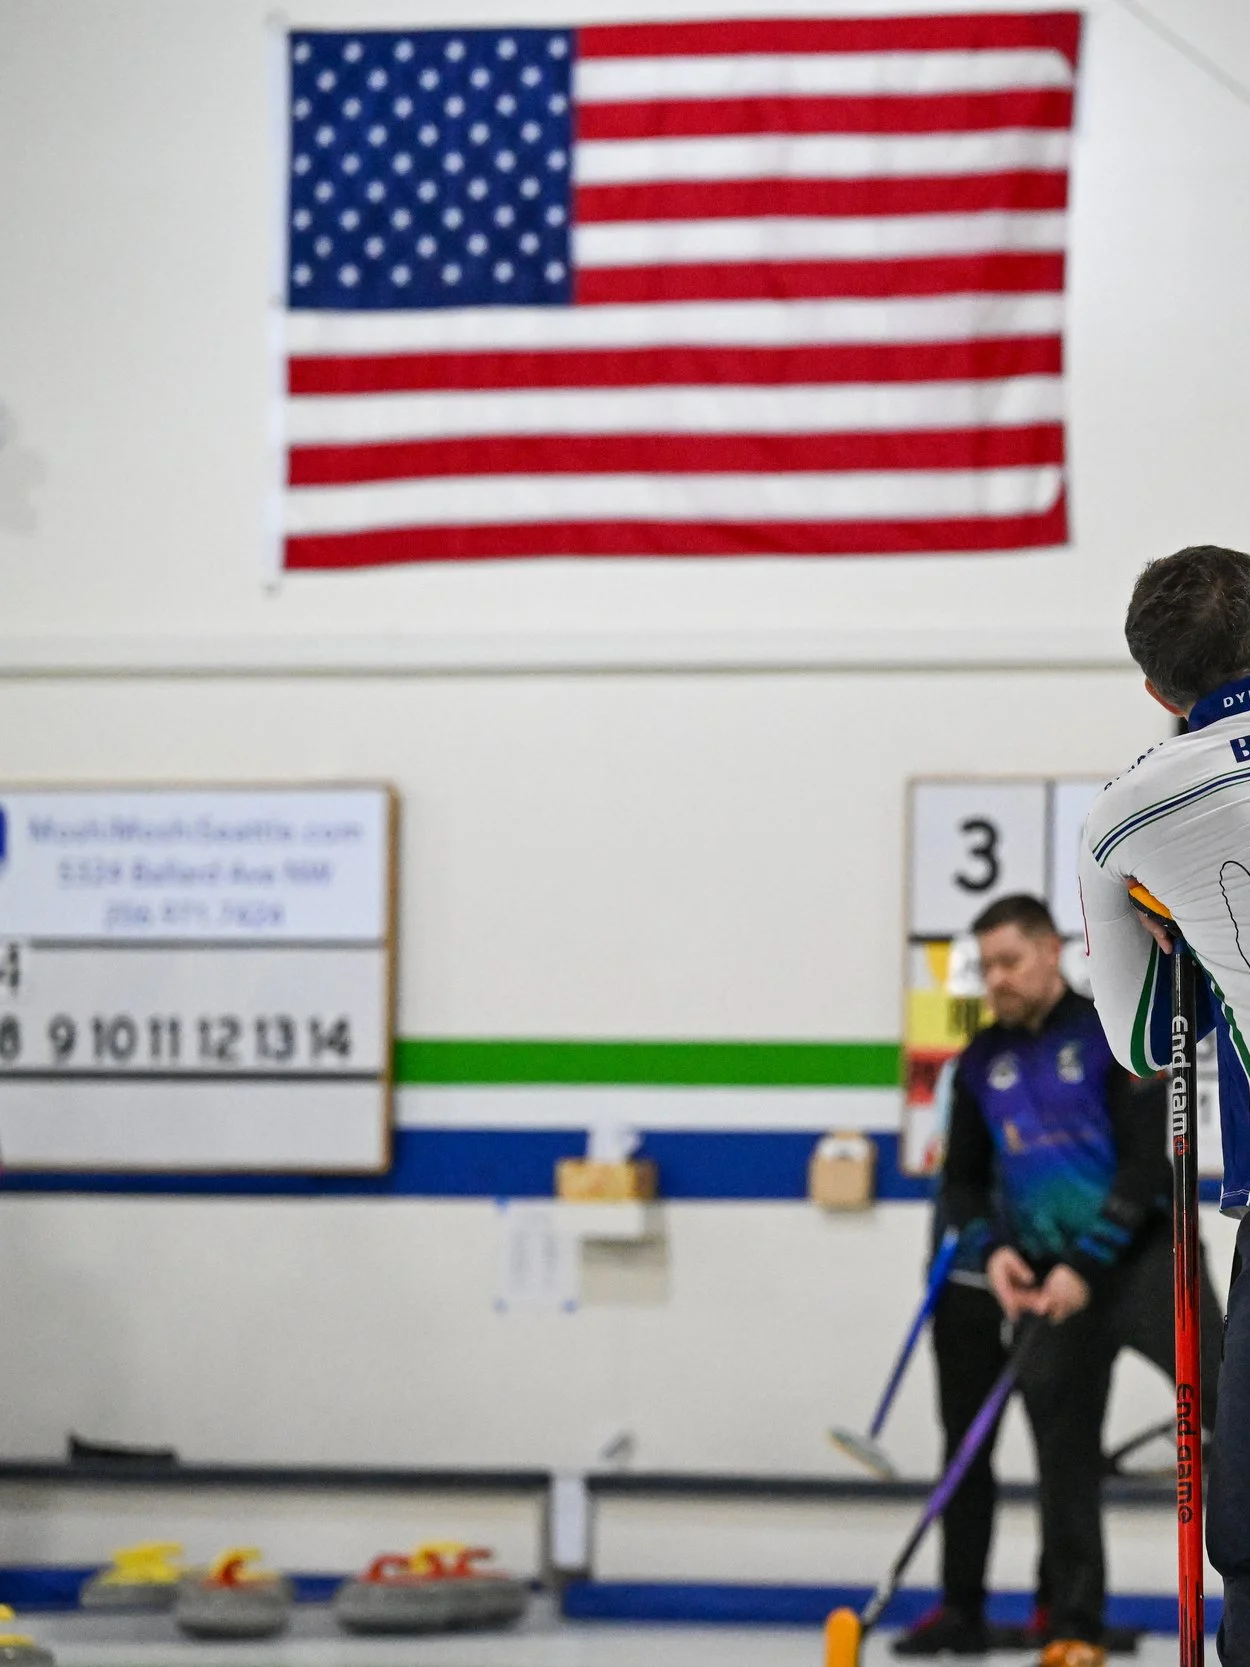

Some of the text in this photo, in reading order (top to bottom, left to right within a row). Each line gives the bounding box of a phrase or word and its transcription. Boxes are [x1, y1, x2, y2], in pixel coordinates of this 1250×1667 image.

[954, 816, 1000, 891] 3
[49, 1015, 77, 1062] 9
[93, 1015, 138, 1062] 10
[149, 1015, 181, 1060] 11
[198, 1015, 241, 1062] 12
[255, 1015, 297, 1062] 13
[309, 1015, 352, 1060] 14
